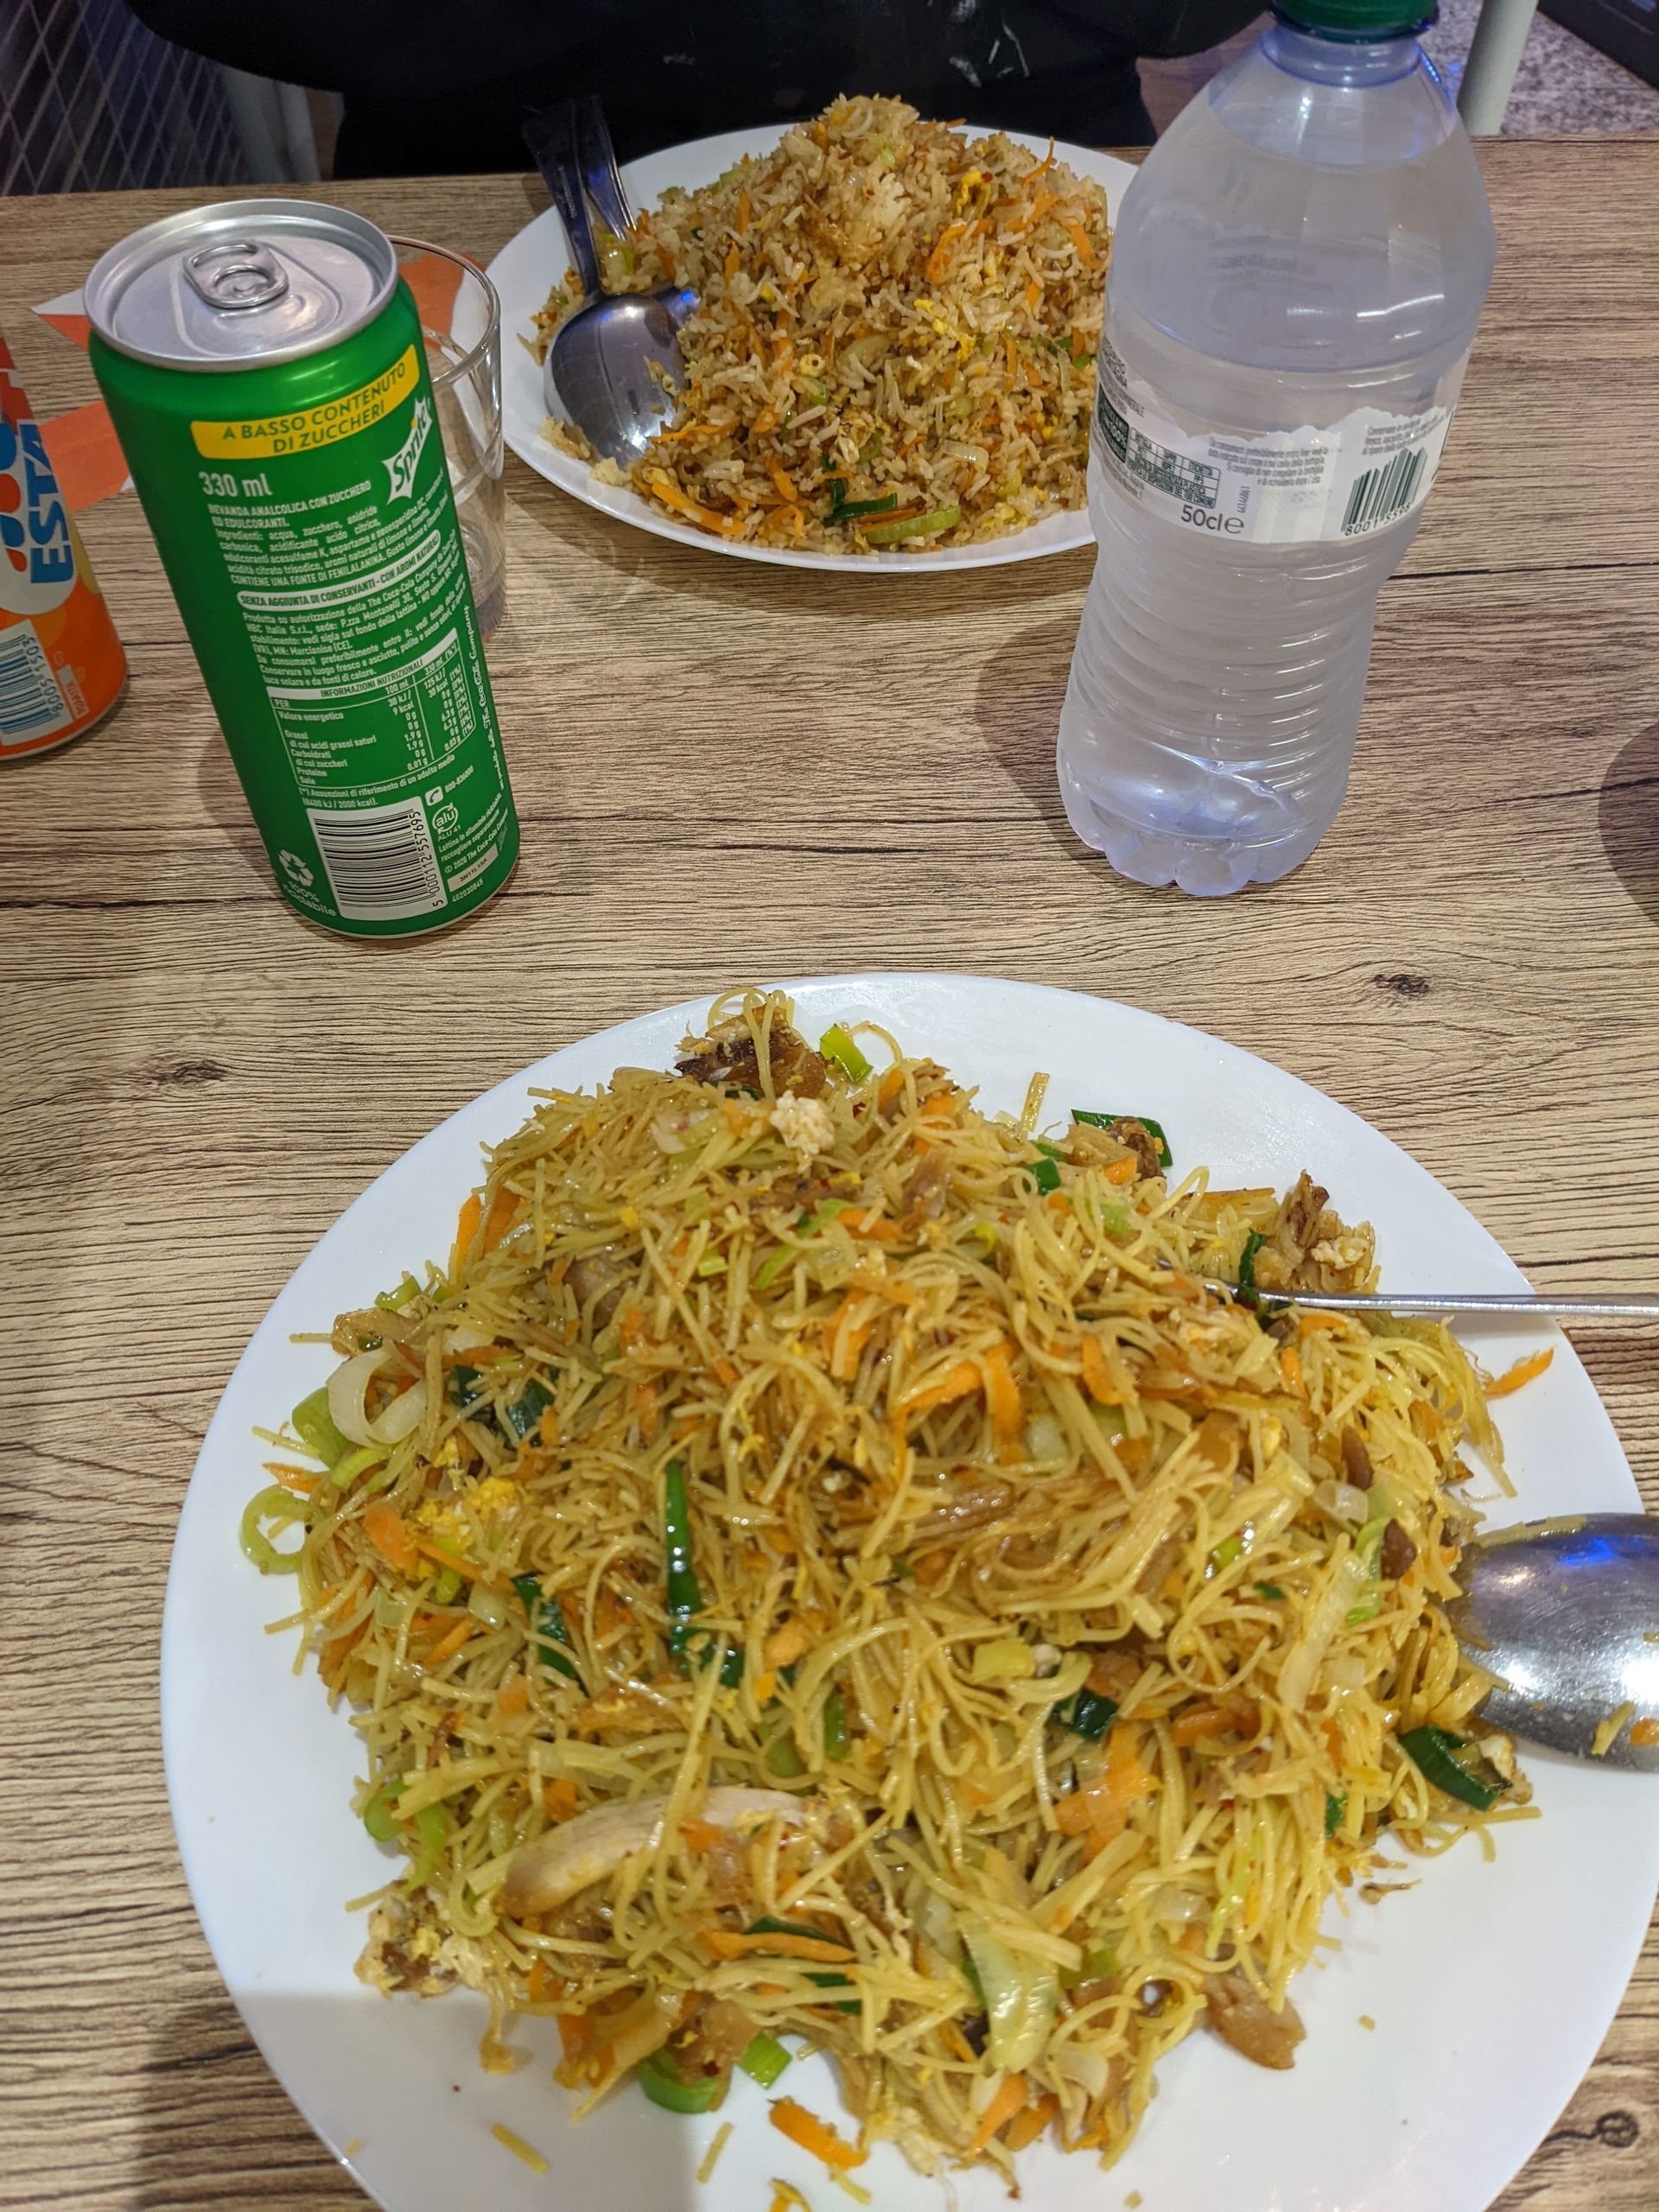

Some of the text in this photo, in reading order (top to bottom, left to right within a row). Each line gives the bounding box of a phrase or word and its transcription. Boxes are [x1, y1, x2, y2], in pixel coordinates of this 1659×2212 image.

[222, 361, 406, 440] A BASSO CONTENUTO
[273, 400, 385, 454] DI ZUCCHERI
[393, 405, 427, 493] Sprite
[199, 472, 273, 498] 330 ml
[207, 480, 371, 516] BEVANDA ANALCOLICA CON ZUCCHERO
[215, 505, 378, 541] Ingredienti: acqua, zucchero, anidride
[225, 517, 289, 529] EDULCORANTI.
[1180, 505, 1222, 531] 50cl
[1344, 518, 1379, 537] 8001
[270, 539, 319, 552] acidificante
[326, 531, 347, 543] acido
[270, 551, 319, 563] acesulfame
[329, 536, 371, 555] aspartame
[230, 575, 270, 586] CONTIENE
[270, 576, 289, 586] UNA
[289, 573, 317, 586] FONTE
[318, 572, 327, 582] DI
[328, 553, 386, 579] FENILALANINA.
[385, 542, 405, 557] Gusto
[241, 537, 439, 607] SENZA AGGIUNTA DI CONSERVANTI CON AROMI NATURALI
[255, 566, 283, 575] citrato
[324, 554, 347, 569] aromi
[348, 543, 378, 562] naturali
[265, 625, 287, 634] Italia
[362, 599, 401, 621] Montanelli
[414, 580, 430, 596] Sesto
[289, 609, 346, 623] autorizzazione
[346, 603, 366, 614] della
[368, 596, 381, 607] The
[382, 579, 415, 602] Coca-Cola
[302, 635, 319, 644] vedi
[320, 632, 340, 644] sigla
[341, 629, 353, 639] sul
[355, 622, 377, 635] fondo
[378, 614, 396, 628] della
[396, 601, 417, 619] lattina
[463, 604, 478, 658] Company
[259, 664, 302, 676] Conservare
[312, 666, 335, 677] luogo
[336, 662, 361, 672] fresco
[368, 649, 400, 664] asciutto,
[400, 637, 419, 654] pulito
[271, 657, 316, 665] consumarsi
[321, 645, 378, 665] preferibilmente
[383, 635, 402, 648] entro
[289, 645, 333, 655] Marcianise
[334, 640, 353, 652] (CE).
[23, 637, 64, 714] 8005 1503
[280, 677, 304, 686] solare
[322, 676, 340, 685] fonti
[341, 673, 350, 682] di
[350, 668, 377, 680] calore.
[320, 659, 423, 698] INFORMAZIONI NUTRIZIONALI
[275, 699, 289, 709] PER
[385, 683, 399, 695] 100
[399, 678, 410, 690] ml
[277, 710, 303, 721] Valore
[303, 712, 344, 722] energetico
[398, 701, 415, 715] kcal
[482, 705, 493, 728] The
[311, 741, 329, 749] acidi
[329, 740, 353, 751] grassi
[354, 734, 377, 747] saturi
[296, 766, 327, 777] Proteine
[311, 788, 348, 798] Assunzioni
[349, 787, 358, 796] di
[358, 783, 399, 796] riferimento
[407, 774, 416, 785] un
[417, 766, 438, 781] adulto
[438, 753, 455, 771] medio
[316, 759, 348, 768] zuccheri
[299, 776, 316, 785] Sale
[338, 796, 378, 807] 2000 kcal).
[436, 810, 455, 828] alu
[437, 824, 461, 842] ALU 41
[438, 836, 459, 853] Lattina
[409, 811, 444, 907] 5 000112 557695
[441, 840, 472, 862] raccogliere
[453, 857, 467, 870] 2020
[467, 849, 477, 861] The
